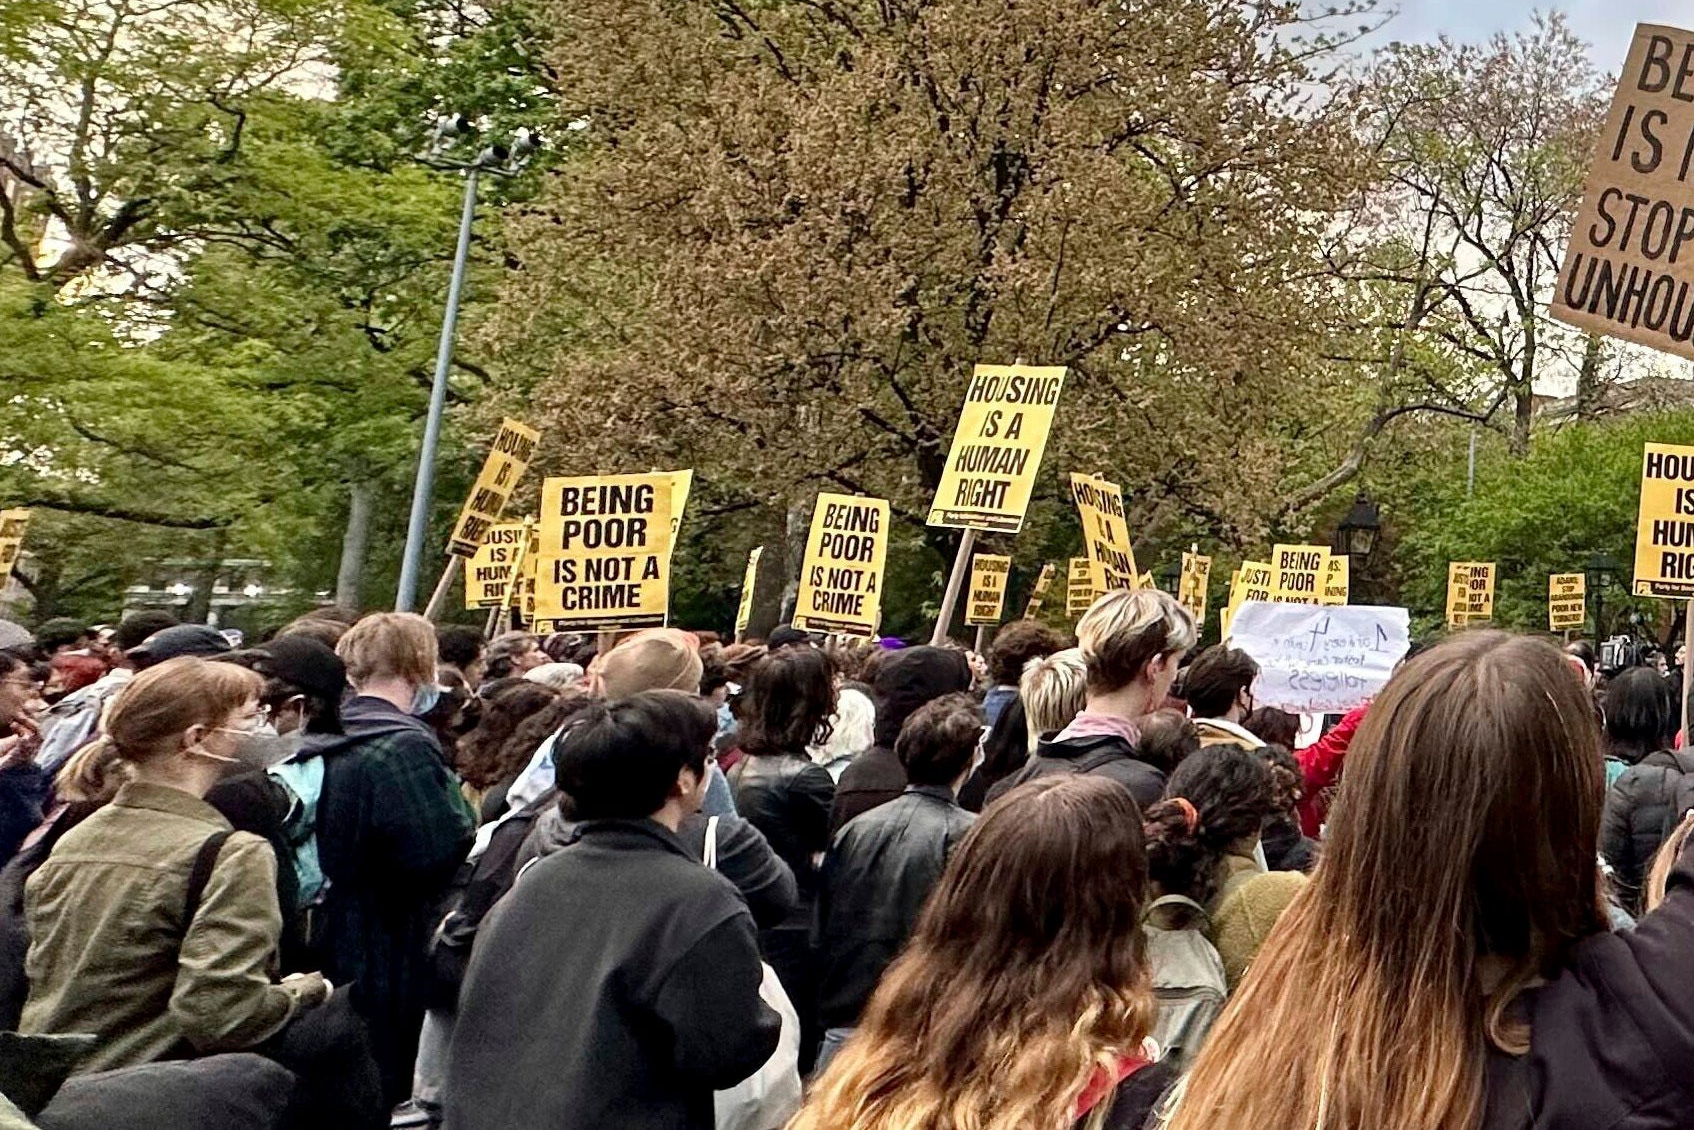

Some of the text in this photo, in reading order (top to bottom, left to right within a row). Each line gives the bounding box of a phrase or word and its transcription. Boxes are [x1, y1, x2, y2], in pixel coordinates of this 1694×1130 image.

[1611, 105, 1668, 174] IS
[969, 375, 1060, 406] HOUSING
[978, 409, 1024, 440] IS A
[954, 445, 1030, 476] HUMAN
[560, 483, 655, 517] BEING
[954, 478, 1012, 509] RIGHT
[562, 517, 647, 550] POOR
[823, 503, 880, 534] BEING
[490, 547, 507, 563] IS
[818, 532, 875, 563] POOR
[1280, 551, 1321, 571] BEING
[553, 555, 660, 585] IS NOT A
[809, 565, 877, 594] IS NOT A
[1279, 571, 1315, 592] POOR
[1470, 566, 1489, 578] ING
[561, 583, 642, 611] CRIME
[812, 589, 865, 616] CRIME
[1484, 593, 1490, 603] A
